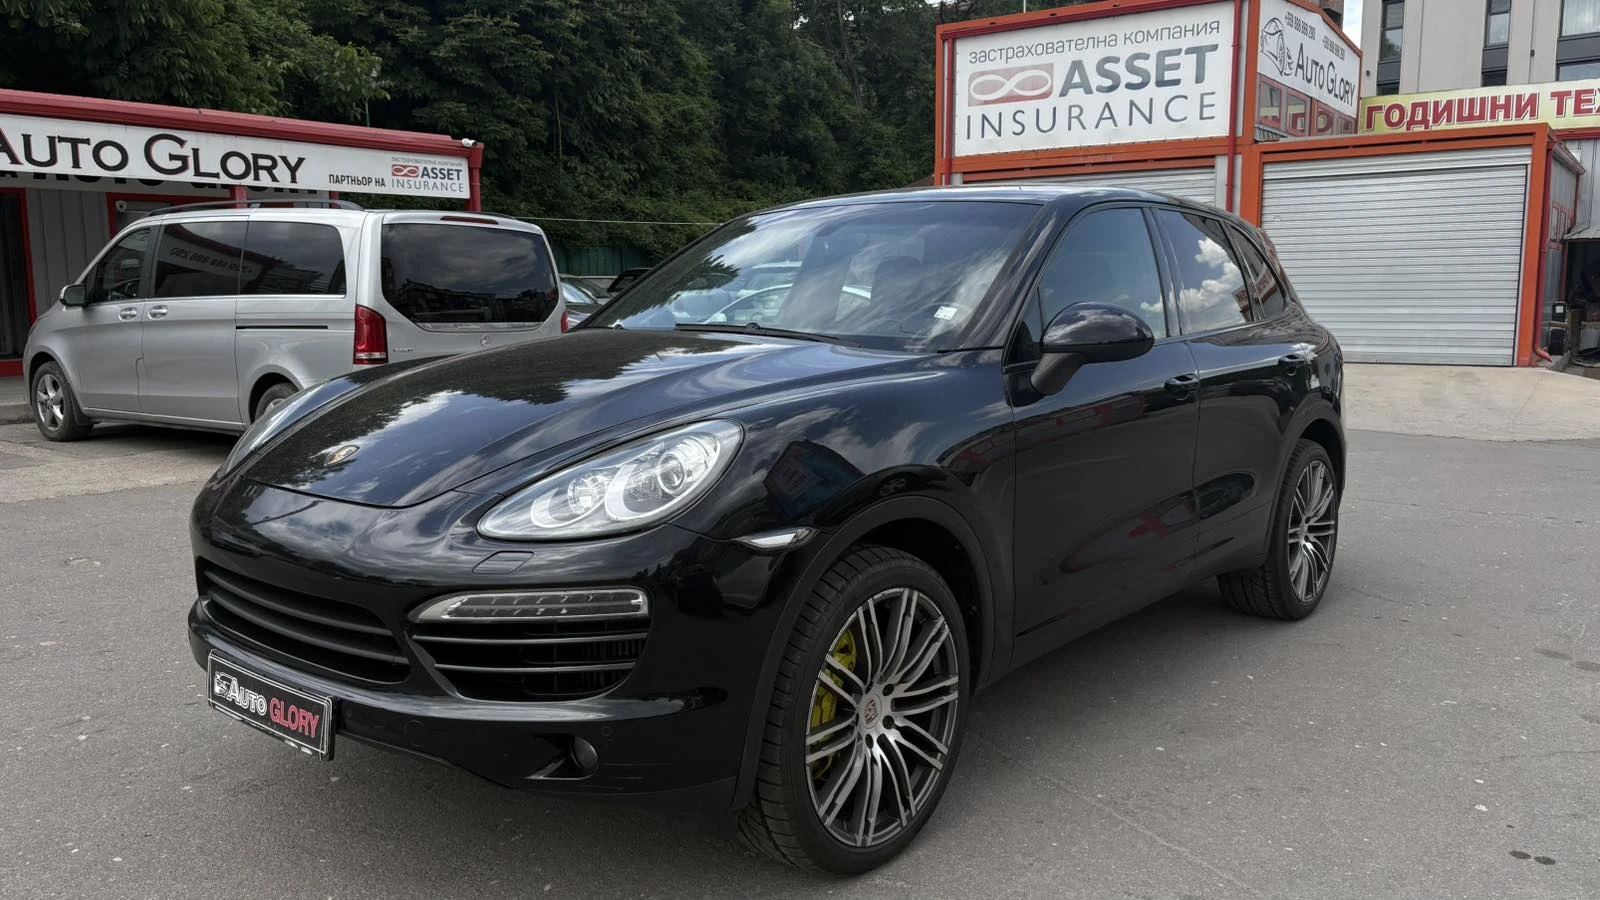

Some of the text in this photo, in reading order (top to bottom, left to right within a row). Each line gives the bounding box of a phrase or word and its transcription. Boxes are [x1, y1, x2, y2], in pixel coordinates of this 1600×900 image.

[968, 20, 1220, 64] застрахователна компания
[1058, 43, 1219, 98] ASSET
[1295, 42, 1325, 90] AUTO
[1327, 61, 1356, 107] GLORY
[966, 91, 1217, 140] INSURANCE
[1366, 92, 1539, 131] ГОДИШНИ
[1550, 88, 1600, 118] ТЕ
[144, 133, 306, 184] GLORY
[328, 174, 373, 187] ПАРТНЬОР
[375, 178, 386, 188] НА
[421, 166, 462, 181] ASSET
[391, 178, 464, 193] INSURANCE
[227, 676, 320, 738] AUTO GLORY
